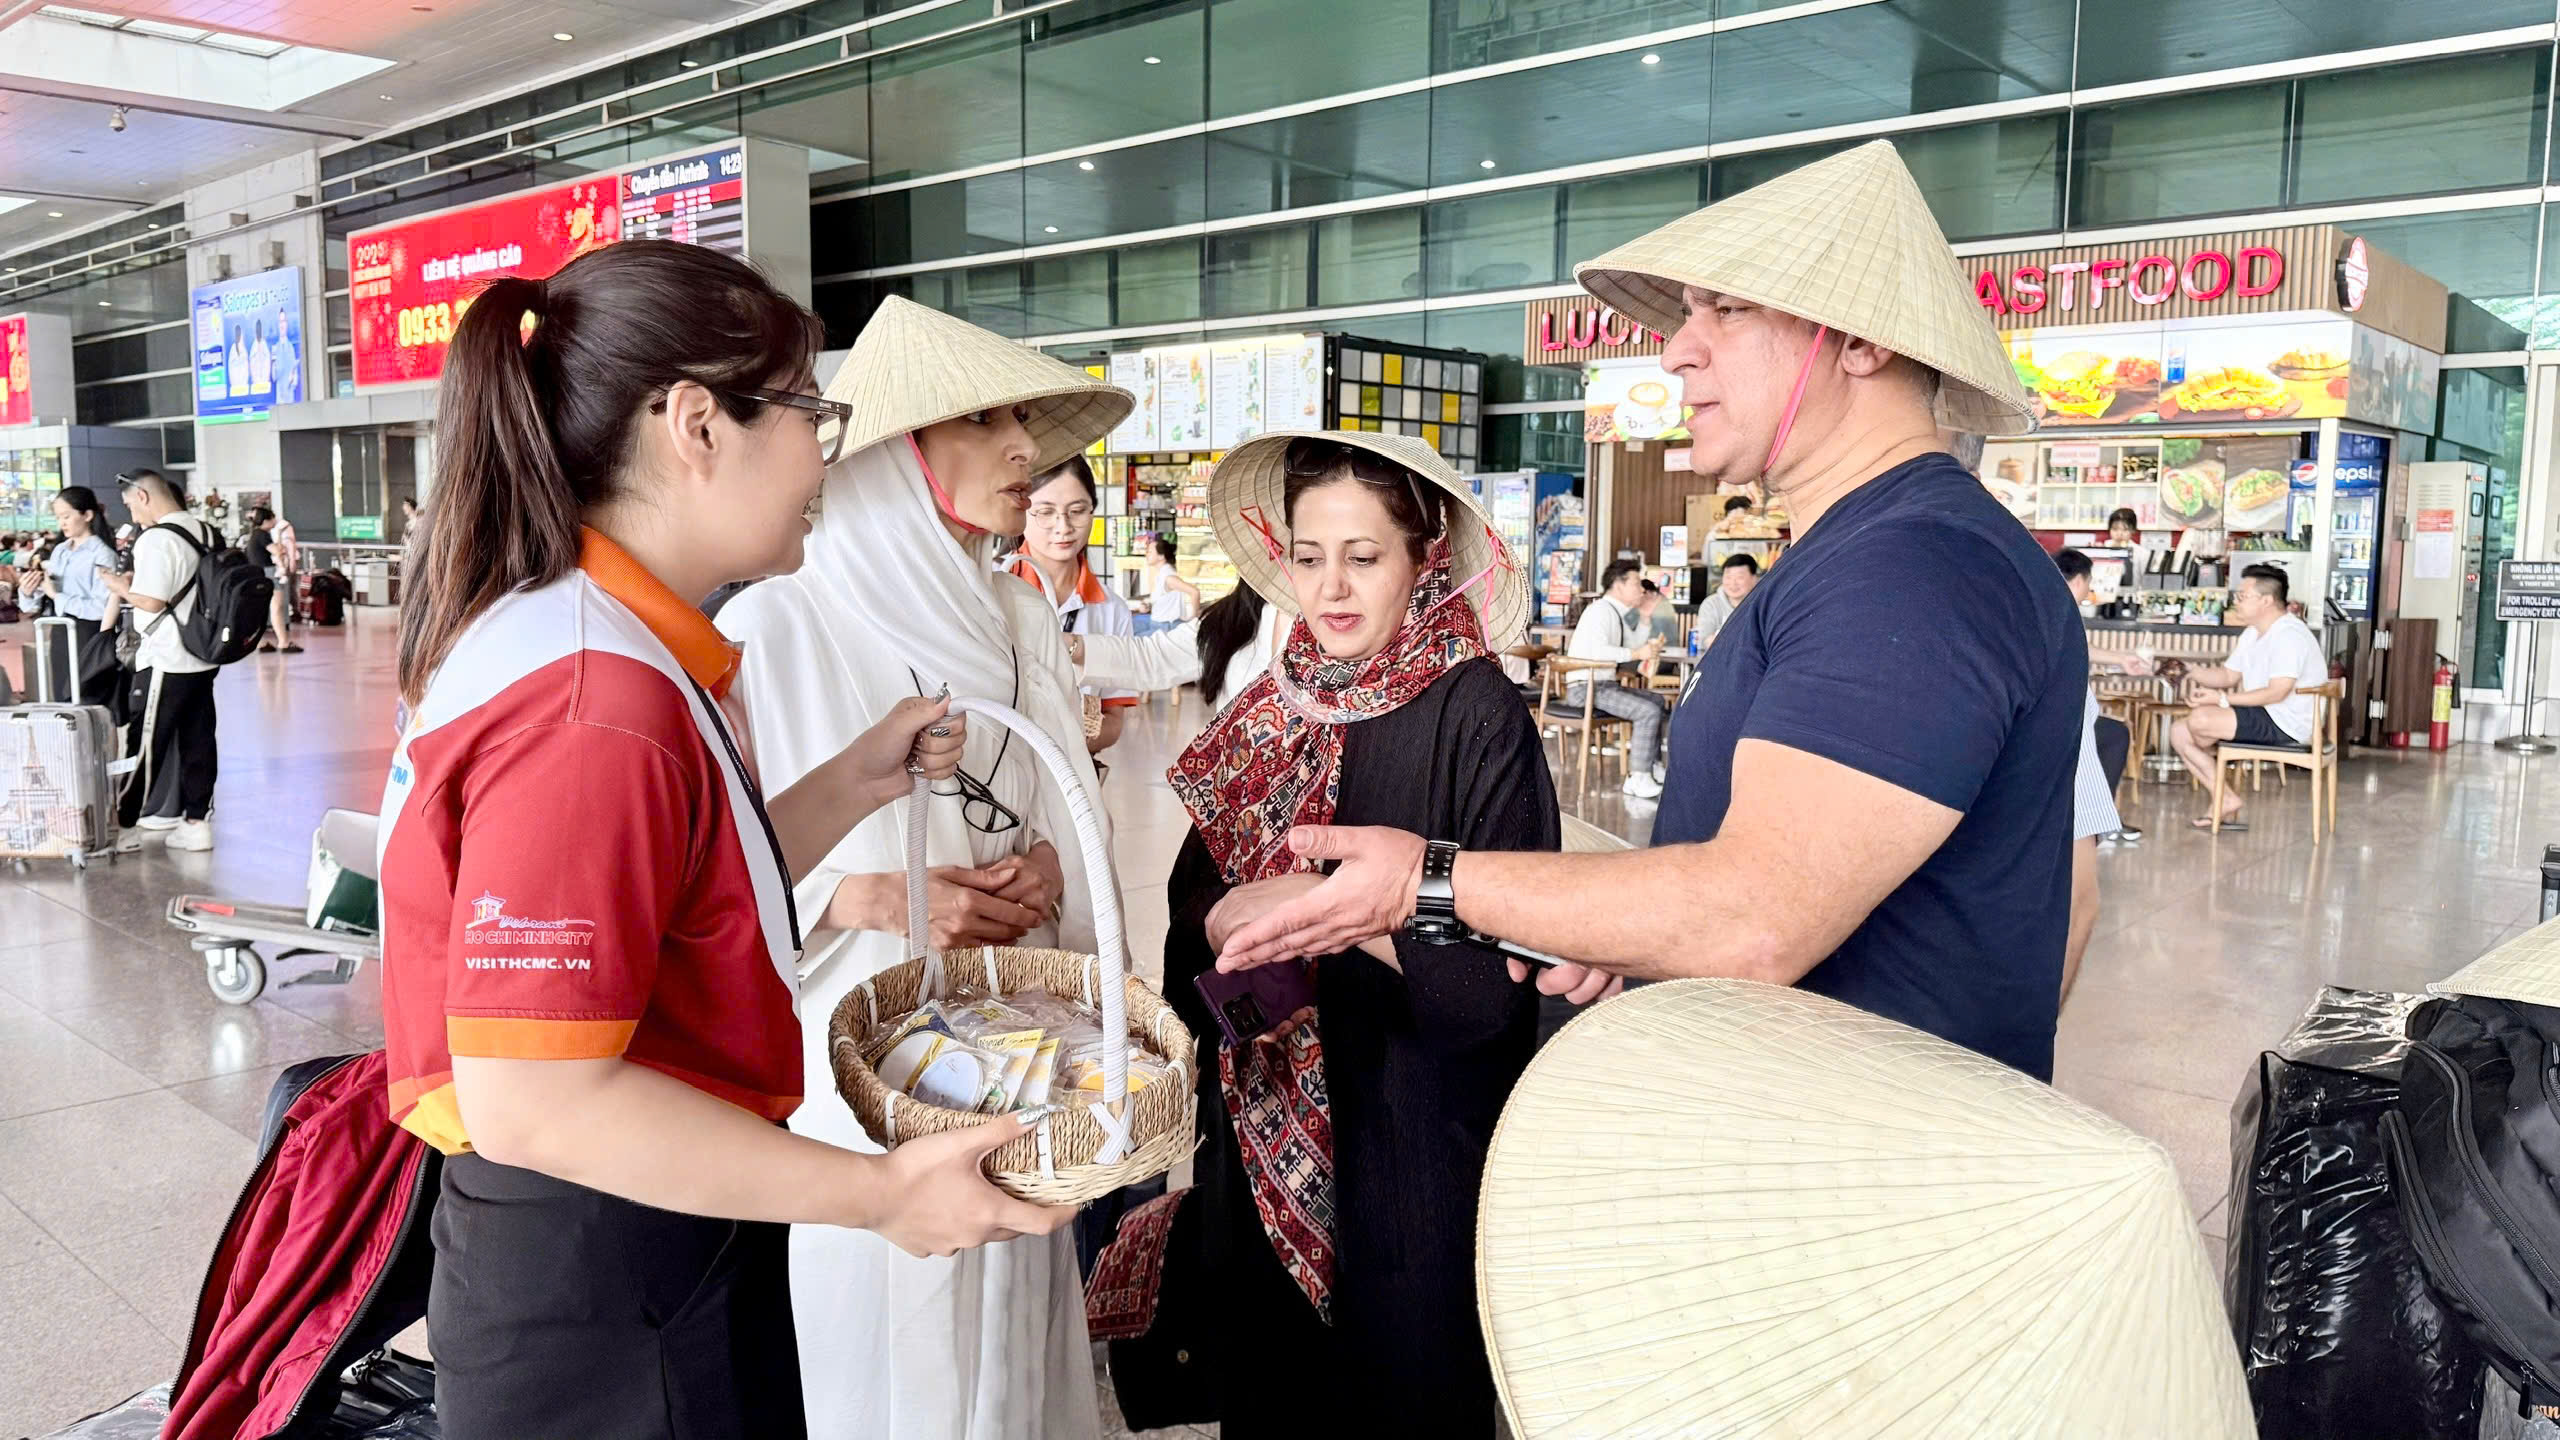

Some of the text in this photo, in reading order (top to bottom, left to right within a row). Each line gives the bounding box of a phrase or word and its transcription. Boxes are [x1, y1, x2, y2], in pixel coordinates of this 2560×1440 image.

[1974, 246, 2284, 316] ASTFOOD
[2334, 465, 2373, 483] epsi
[2507, 596, 2521, 606] FOR
[2521, 596, 2551, 606] TROLLEY
[2501, 606, 2541, 617] EMERGENCY
[392, 764, 408, 785] M
[464, 930, 594, 946] HO CHI MINH CITY
[465, 957, 591, 970] VISITHCMC.VN
